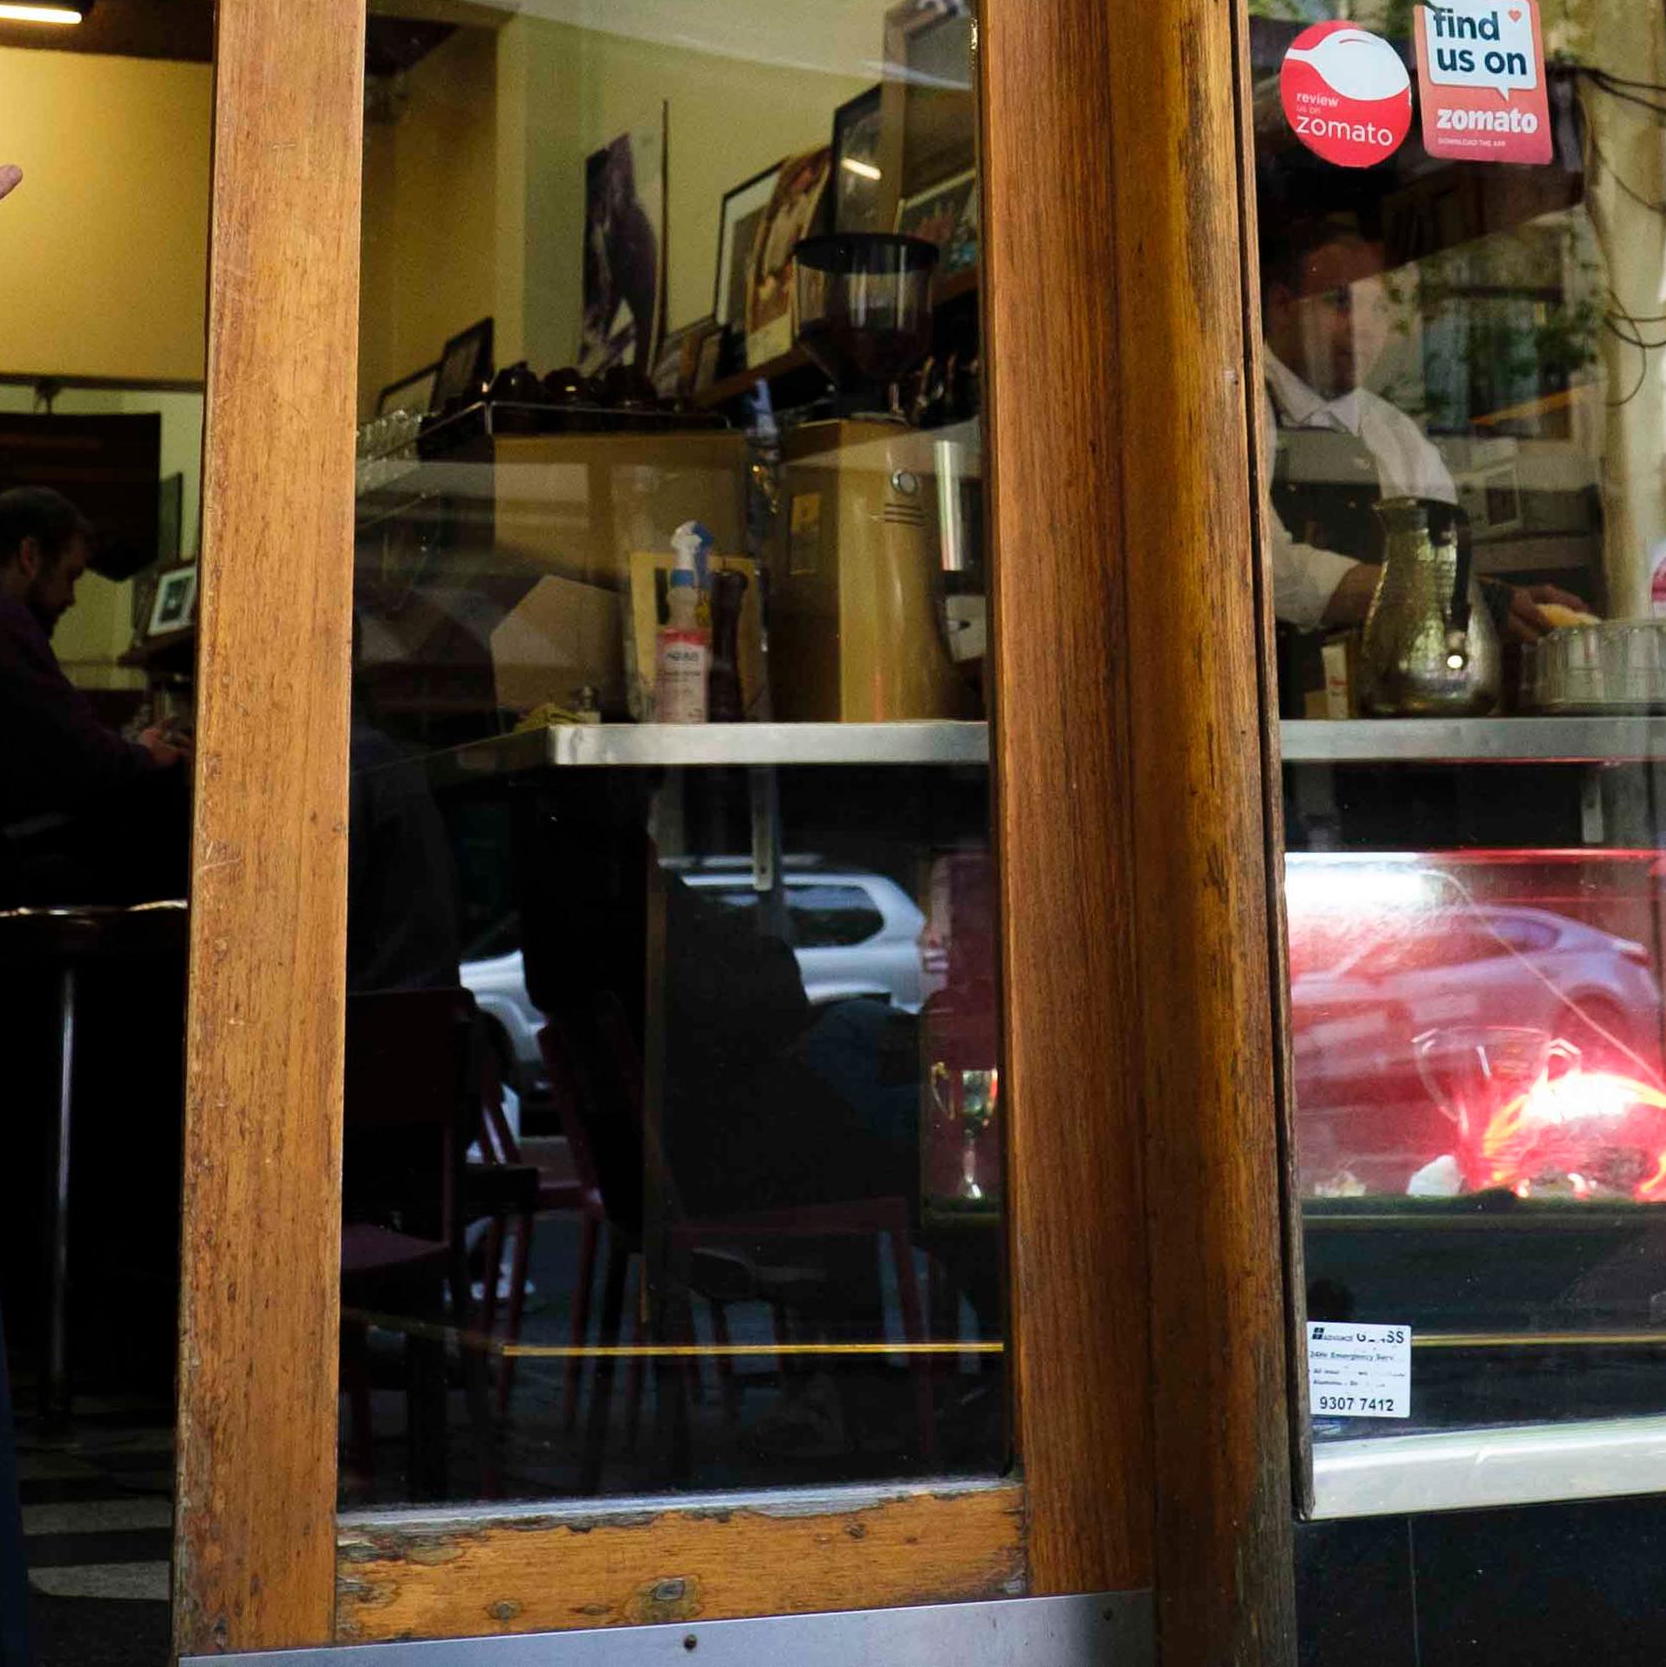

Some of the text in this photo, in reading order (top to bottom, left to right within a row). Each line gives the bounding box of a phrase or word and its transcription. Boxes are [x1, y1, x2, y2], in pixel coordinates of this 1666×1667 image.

[1433, 7, 1501, 41] find
[1437, 47, 1527, 76] us on
[1296, 92, 1339, 108] review
[1296, 105, 1308, 114] us
[1296, 116, 1393, 146] zomato
[1437, 108, 1538, 134] zomato
[1319, 1396, 1395, 1412] 9307 7412
